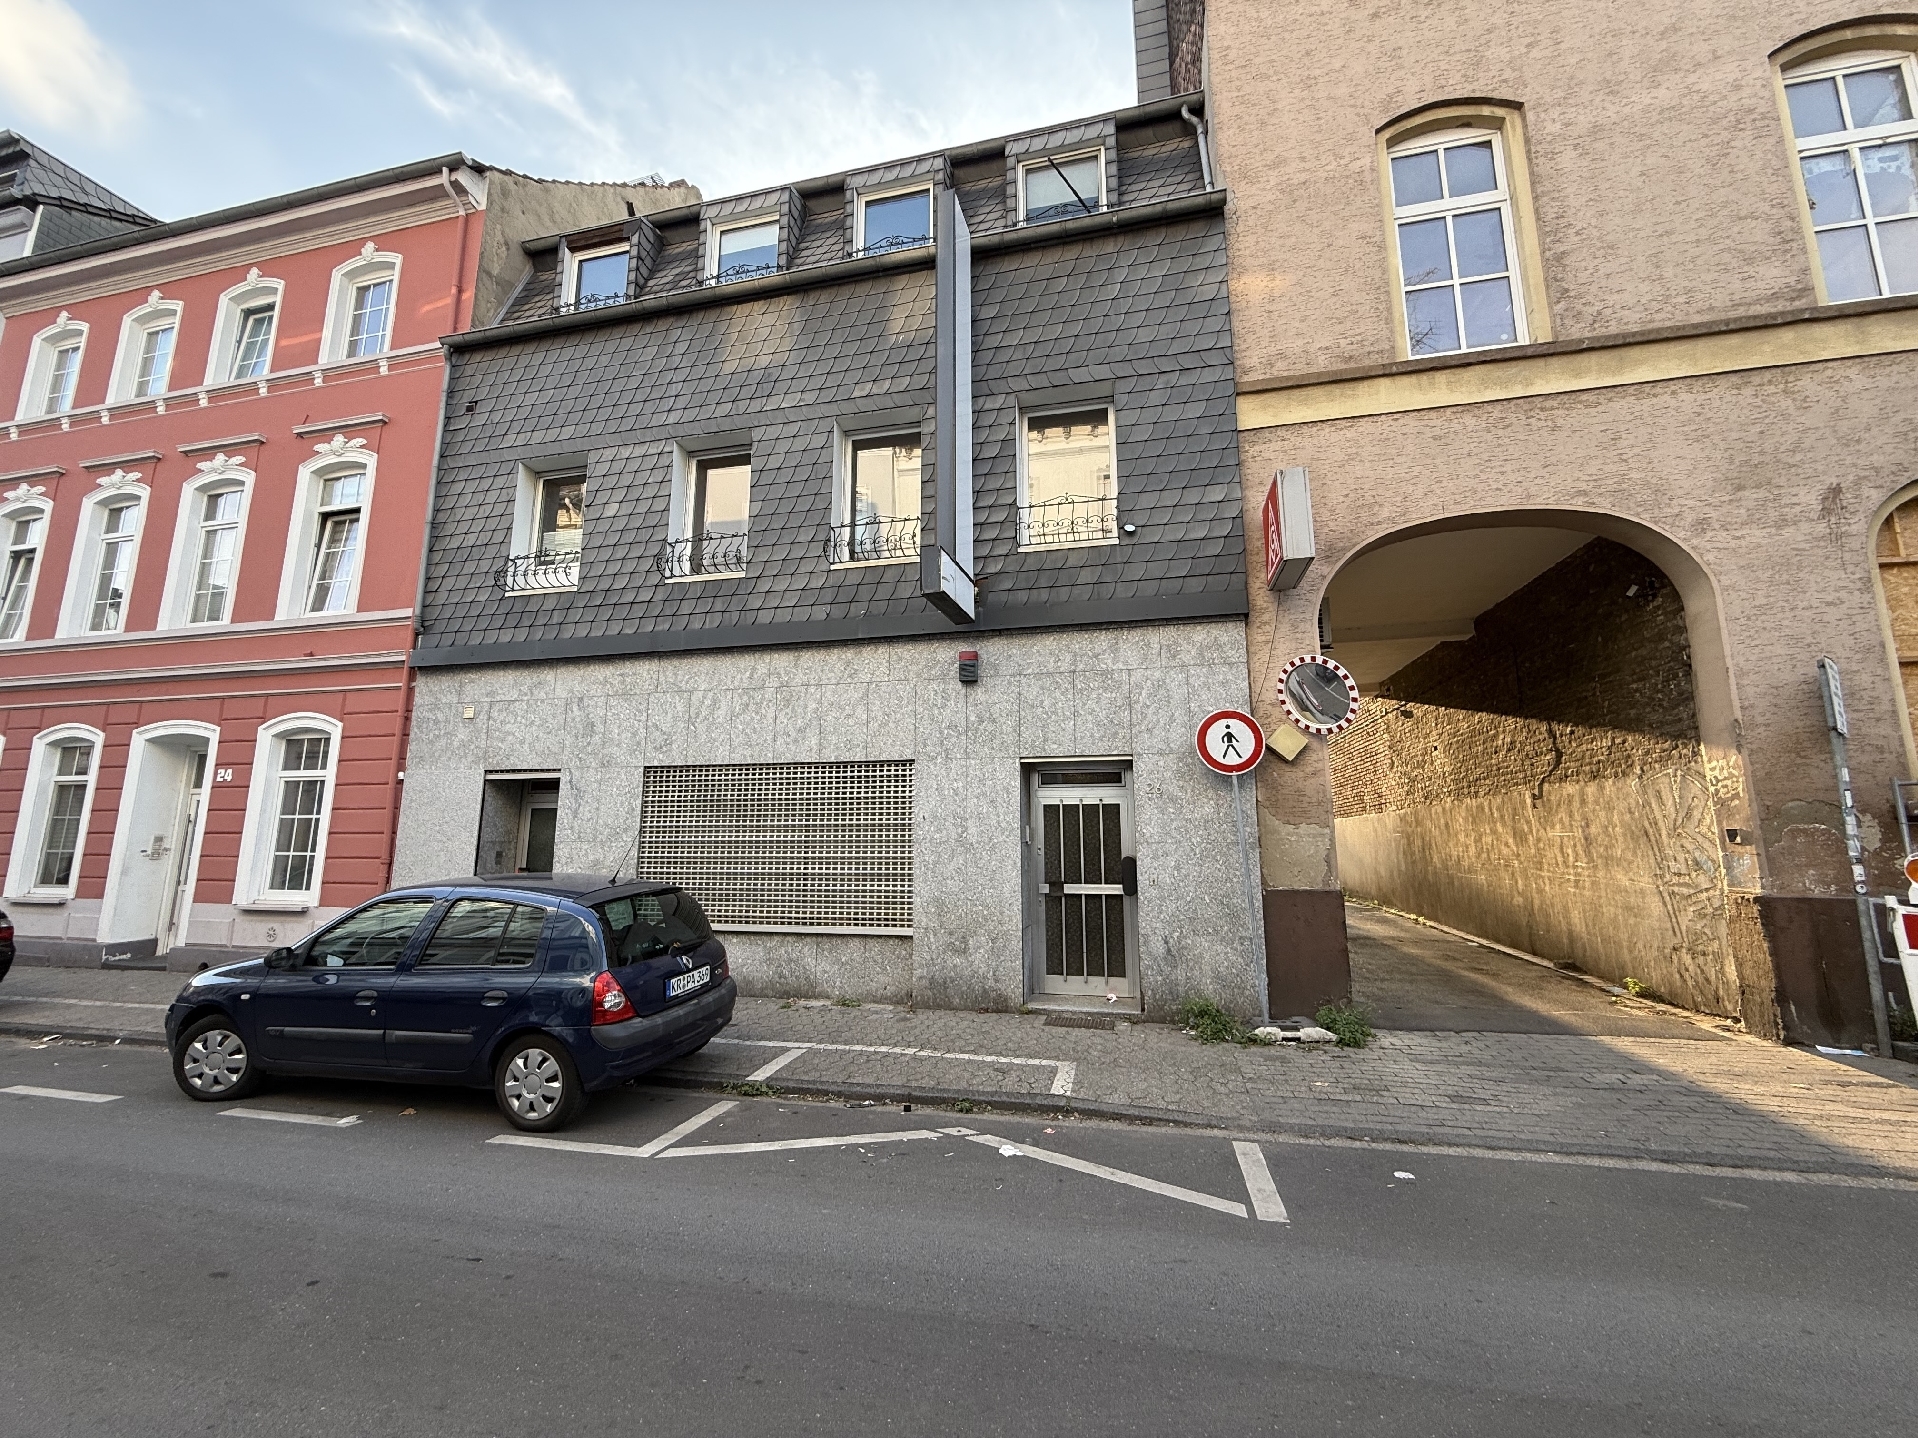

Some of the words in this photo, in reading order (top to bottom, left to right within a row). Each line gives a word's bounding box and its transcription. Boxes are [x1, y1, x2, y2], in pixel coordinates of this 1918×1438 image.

[216, 768, 233, 782] 24
[1146, 782, 1163, 795] 26
[671, 978, 682, 994] KR
[686, 973, 696, 988] PA
